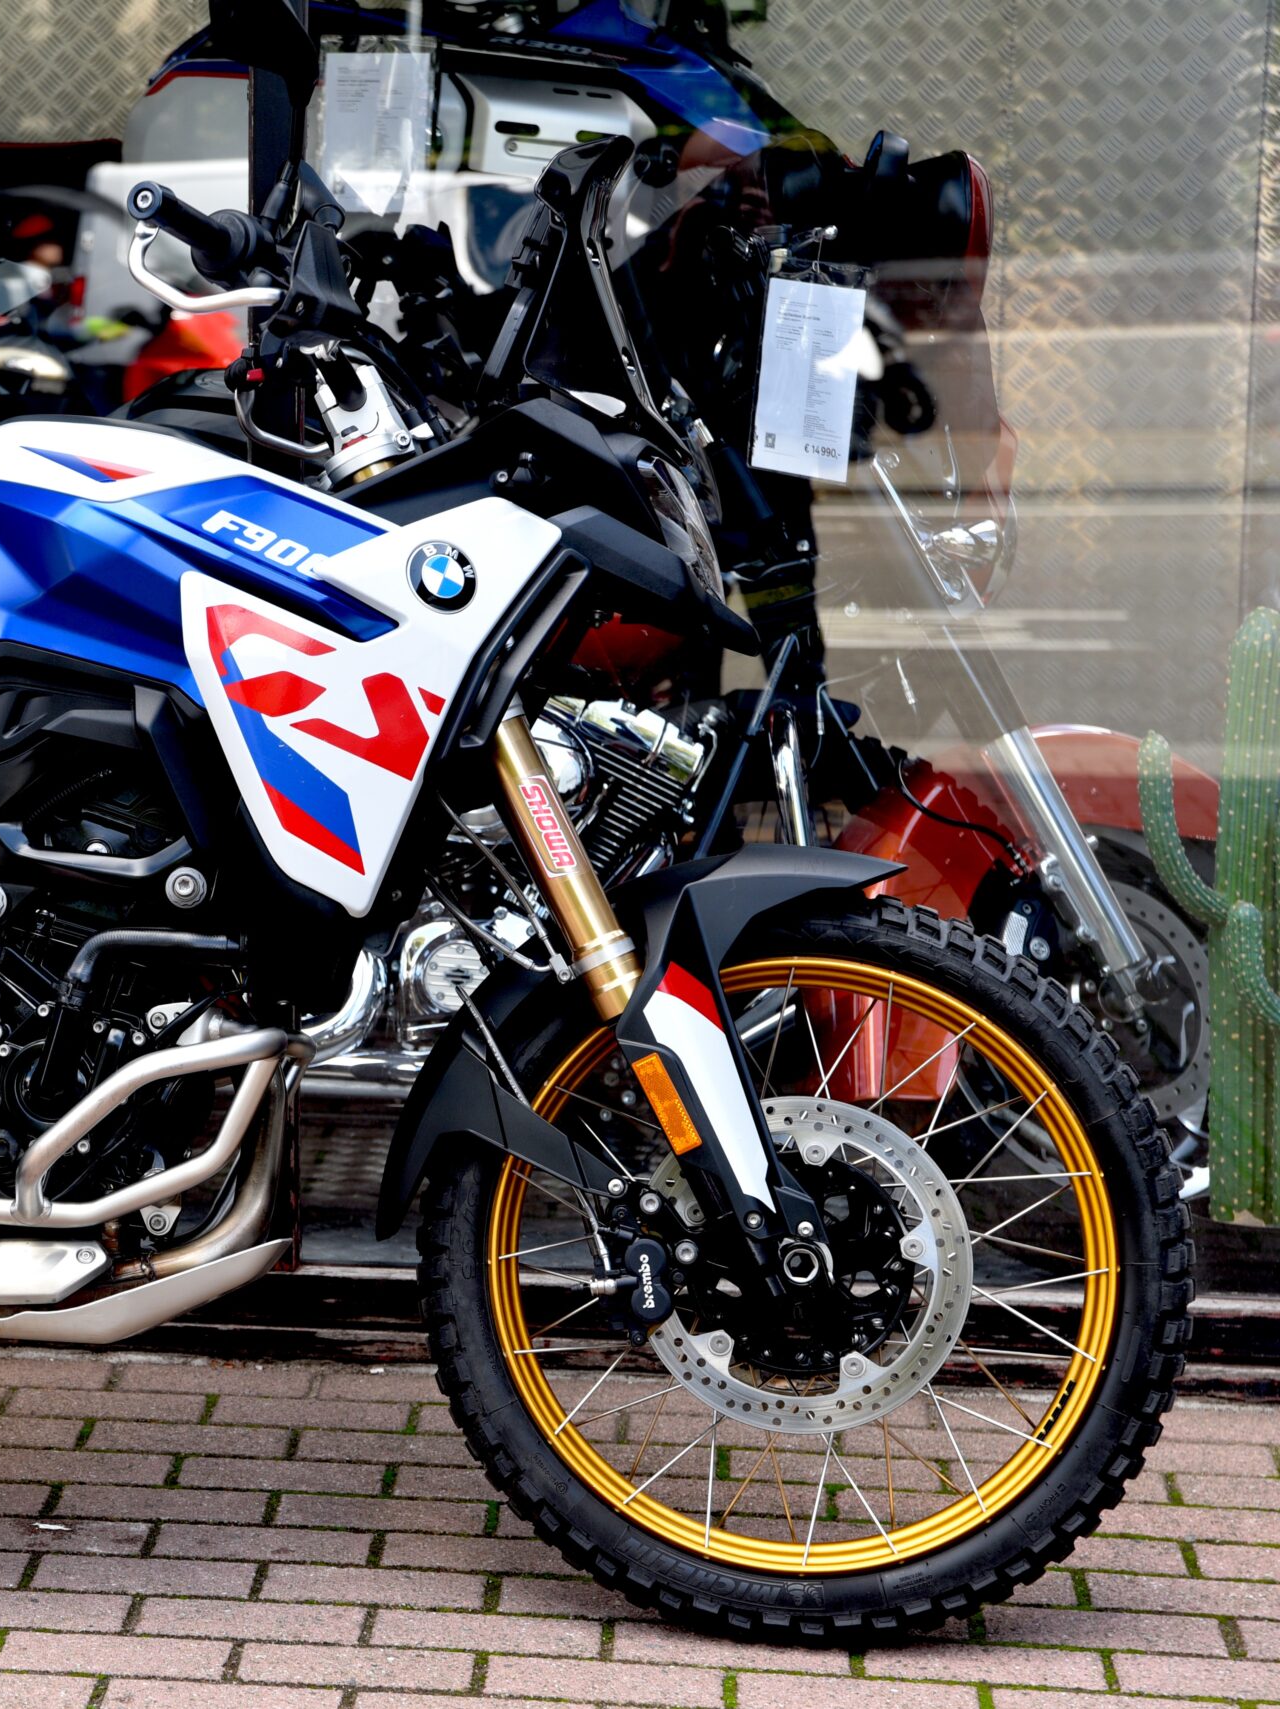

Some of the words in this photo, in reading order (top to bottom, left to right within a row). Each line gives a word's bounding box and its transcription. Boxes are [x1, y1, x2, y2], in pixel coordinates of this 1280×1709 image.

[422, 543, 476, 579] BMW
[519, 784, 577, 869] SHOWA
[638, 1253, 655, 1308] brembo
[621, 1536, 784, 1605] MICHELIN
